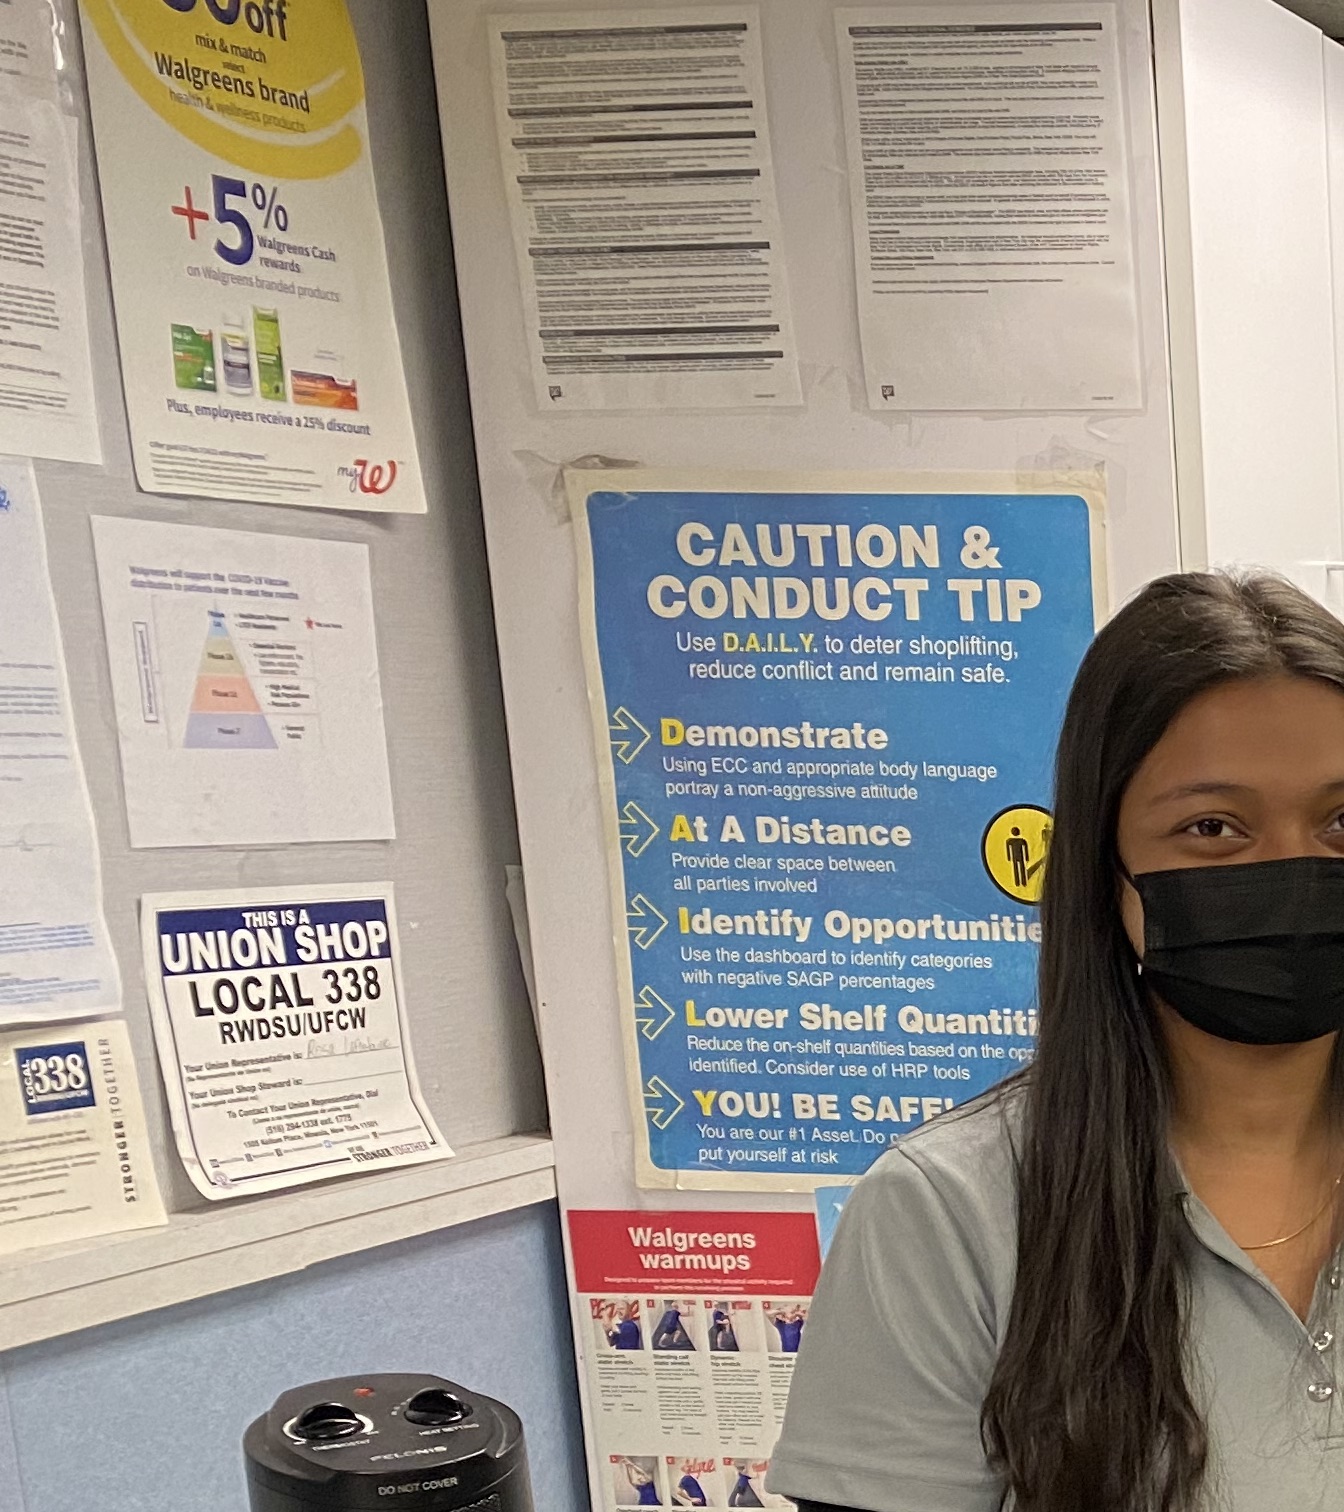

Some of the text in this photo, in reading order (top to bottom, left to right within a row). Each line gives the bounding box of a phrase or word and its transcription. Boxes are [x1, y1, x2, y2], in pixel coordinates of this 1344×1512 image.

[195, 33, 266, 63] mix & match
[155, 51, 310, 114] Walgreens brand
[169, 87, 203, 108] health
[261, 112, 307, 133] products
[256, 235, 336, 262] Walgreens Cash
[187, 265, 340, 302] on Walgreens branded products
[166, 398, 194, 417] Plus,
[195, 405, 253, 423] employees
[256, 411, 292, 426] receive
[295, 416, 301, 427] a
[327, 418, 371, 436] discount
[677, 522, 1002, 569] CAUTION &
[648, 575, 1041, 622] CONDUCT TIP
[677, 632, 1017, 660] Use D.A.I.L.Y. to deter shoplifting,
[690, 660, 1010, 682] reduce conflict and remain safe.
[661, 718, 888, 749] Demonstrate
[663, 757, 996, 782] Using ECC and appropriate body language
[666, 781, 917, 800] portray a non-aggressive attitude
[670, 815, 911, 846] At A Distance
[672, 853, 895, 873] Provide clear space between
[674, 876, 817, 893] all parties involved
[242, 909, 310, 928] THIS IS A
[679, 907, 1041, 944] Identify Opportunitie
[161, 920, 387, 973] UNION SHOP
[681, 947, 992, 971] Use the dashboard to identify categories
[189, 966, 381, 1017] LOCAL 338
[682, 970, 934, 992] with negative SAGP percentages
[220, 1007, 366, 1044] RWDSU/UFCW
[686, 1000, 1039, 1036] Lower Shelf Quantiti
[688, 1035, 742, 1051] Reduce
[746, 1038, 769, 1052] the
[774, 1039, 831, 1053] on-shelf
[835, 1042, 904, 1057] quantities
[908, 1042, 954, 1057] based
[958, 1047, 977, 1058] on
[981, 1044, 1004, 1058] the
[21, 1059, 37, 1103] LOCAL
[31, 1053, 87, 1093] 338
[97, 1038, 124, 1114] TOGETHER
[690, 1058, 970, 1080] identified. Consider use of HRP tools
[692, 1090, 781, 1118] YOU!
[792, 1094, 840, 1120] BE
[696, 1124, 725, 1138] You
[730, 1128, 754, 1139] are
[759, 1130, 784, 1140] our
[789, 1128, 805, 1140] #1
[863, 1129, 885, 1143] Do
[113, 1120, 137, 1203] STRONGER
[352, 1148, 391, 1163] STRONGER
[392, 1140, 429, 1157] TOGETHER
[699, 1147, 838, 1164] put yourself at risk
[628, 1227, 756, 1252] Walgreens
[640, 1254, 751, 1274] warmups
[378, 1477, 458, 1496] DO NOT COVER
